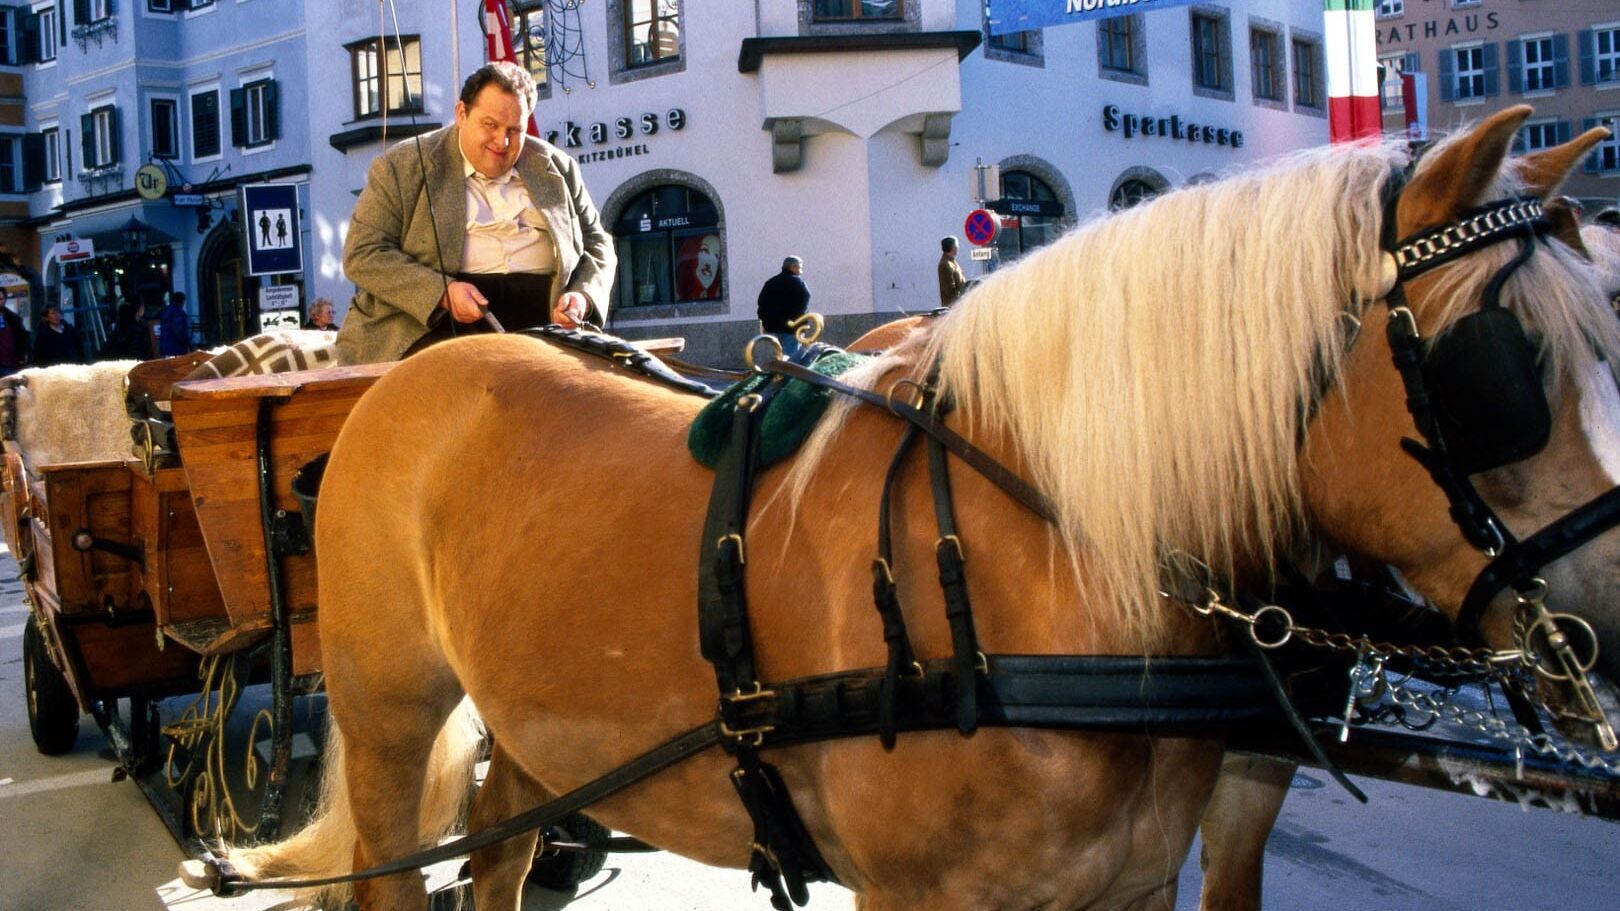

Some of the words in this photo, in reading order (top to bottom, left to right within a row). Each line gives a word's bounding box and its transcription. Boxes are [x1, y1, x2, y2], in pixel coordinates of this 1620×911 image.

[1376, 12, 1499, 45] RATHAUS
[1103, 104, 1244, 148] Sparkasse
[578, 144, 649, 164] KITZBÜHEL
[658, 217, 690, 228] AKTUELL
